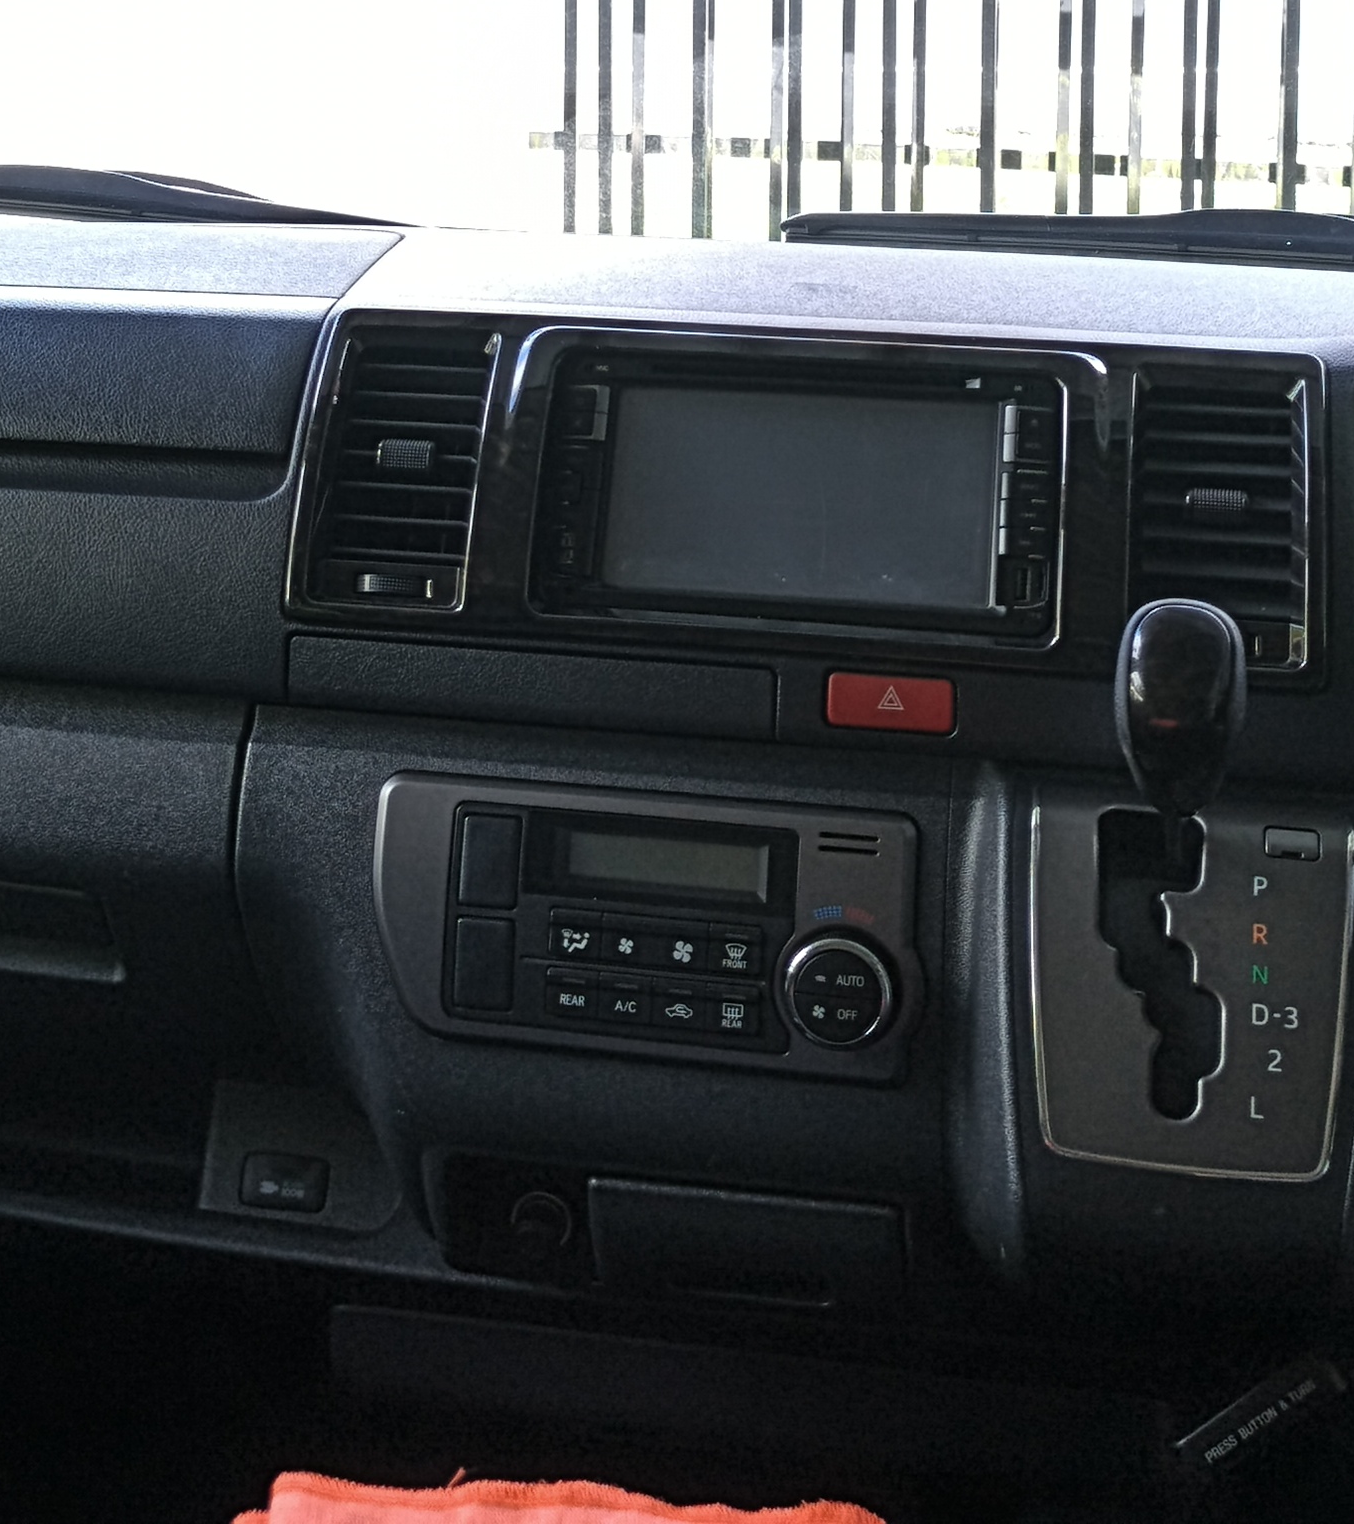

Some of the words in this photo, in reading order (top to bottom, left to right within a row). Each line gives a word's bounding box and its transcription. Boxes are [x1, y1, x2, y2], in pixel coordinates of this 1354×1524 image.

[1252, 876, 1268, 897] P
[1252, 923, 1269, 946] R
[722, 958, 748, 969] FRONT
[835, 975, 865, 987] AUTO
[1251, 964, 1269, 985] N
[559, 993, 586, 1007] REAR
[614, 1000, 638, 1013] A/C
[837, 1009, 858, 1021] OFF
[721, 1019, 743, 1029] REAR
[1267, 1049, 1283, 1073] 2
[1250, 1095, 1264, 1119] L
[1205, 1435, 1238, 1464] PRESS
[1238, 1406, 1279, 1440] BUTTON
[1277, 1399, 1289, 1411] &
[1287, 1379, 1317, 1402] TURN
